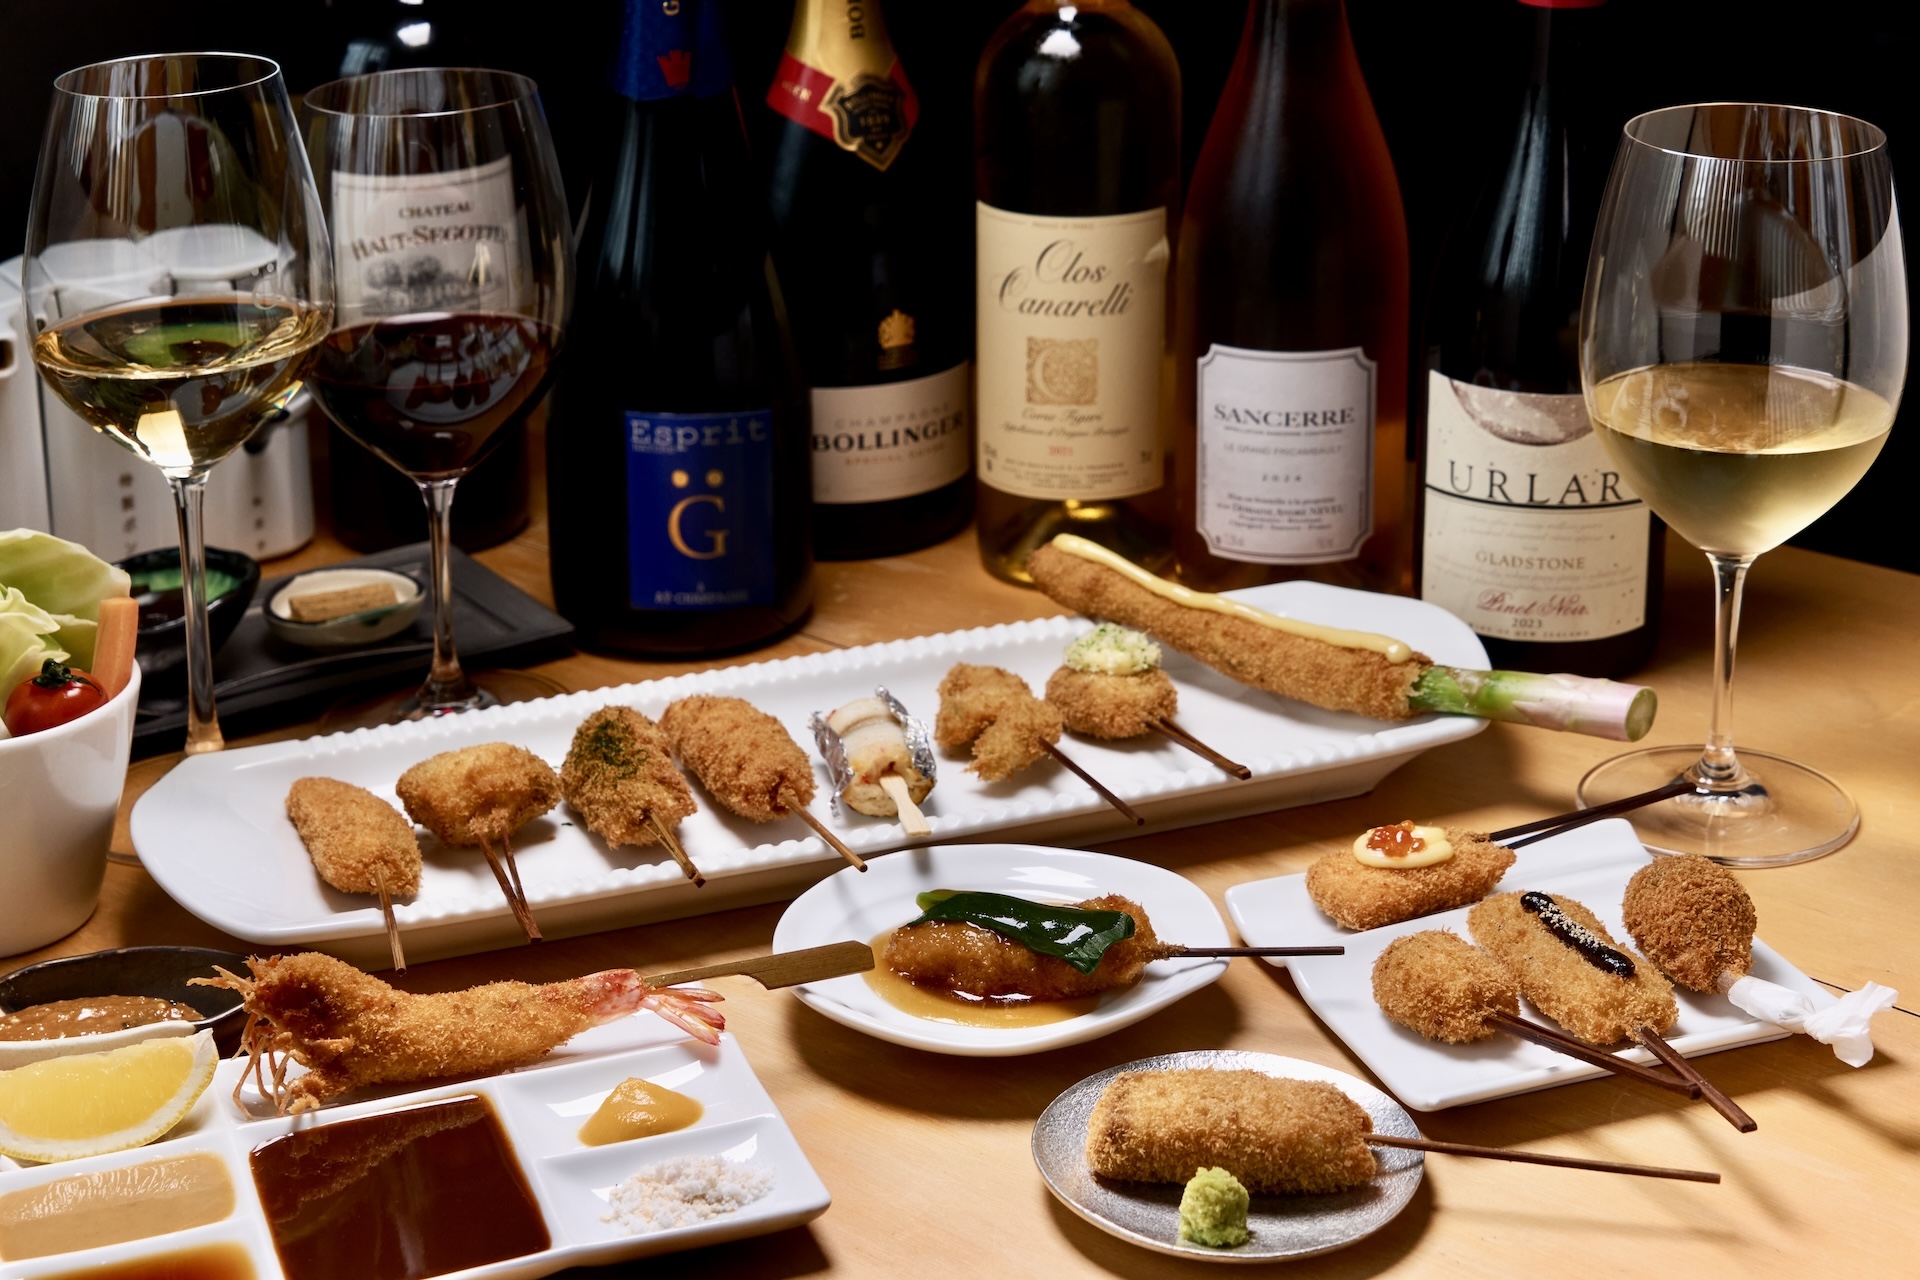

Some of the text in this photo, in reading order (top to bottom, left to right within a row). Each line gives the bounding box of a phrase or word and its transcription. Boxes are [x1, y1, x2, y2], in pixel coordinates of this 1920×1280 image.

[1035, 238, 1109, 284] Clos
[992, 265, 1133, 318] Canarelli
[630, 417, 767, 452] Esprit
[812, 409, 965, 452] BOLLINGER
[1214, 403, 1356, 428] SANCERRE
[1449, 460, 1624, 505] URLAR
[667, 494, 730, 560] G
[1475, 550, 1586, 570] GLADSTONE
[1475, 588, 1535, 615] Pinot
[1511, 617, 1544, 630] 2023
